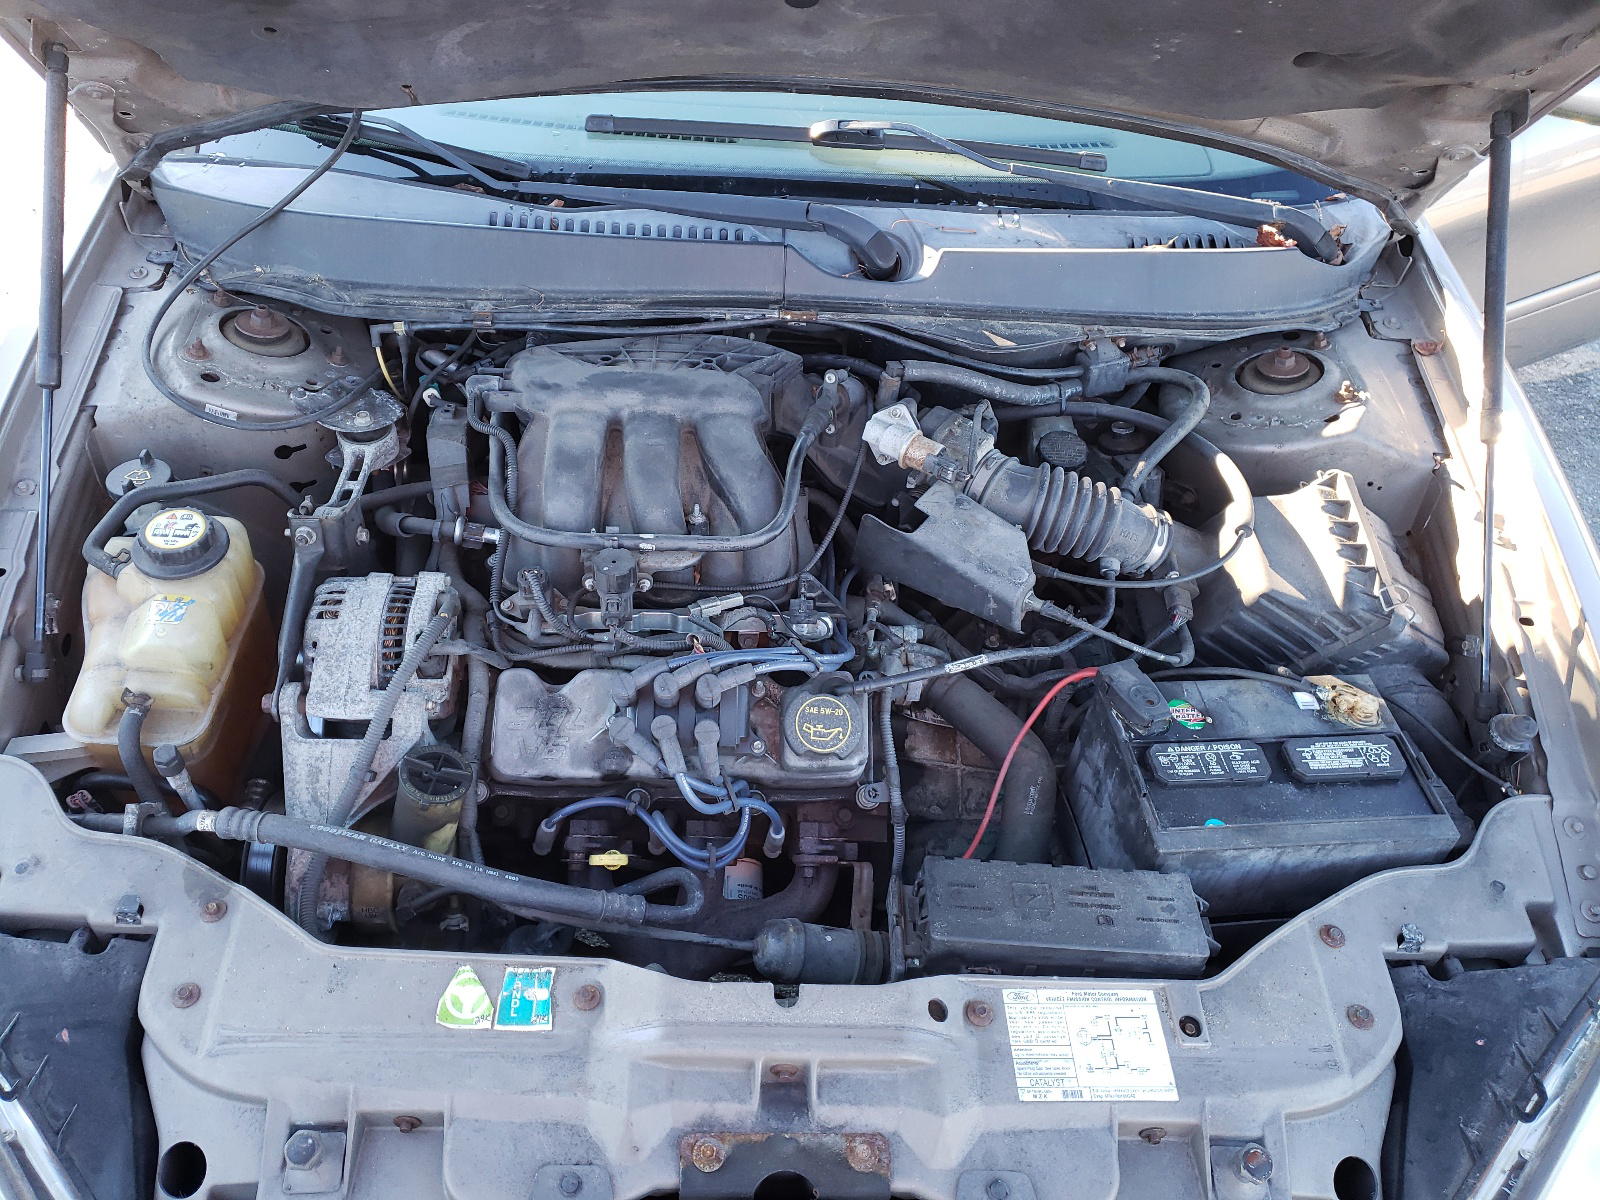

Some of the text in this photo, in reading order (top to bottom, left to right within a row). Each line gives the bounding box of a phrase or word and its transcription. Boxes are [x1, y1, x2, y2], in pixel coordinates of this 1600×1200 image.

[805, 706, 843, 716] SAE 5W-20
[1213, 743, 1242, 751] POISON
[309, 824, 367, 841] GOODYEAR
[369, 837, 409, 852] GALAXY
[1012, 992, 1030, 1000] Ford
[1029, 1078, 1065, 1087] CATALYST
